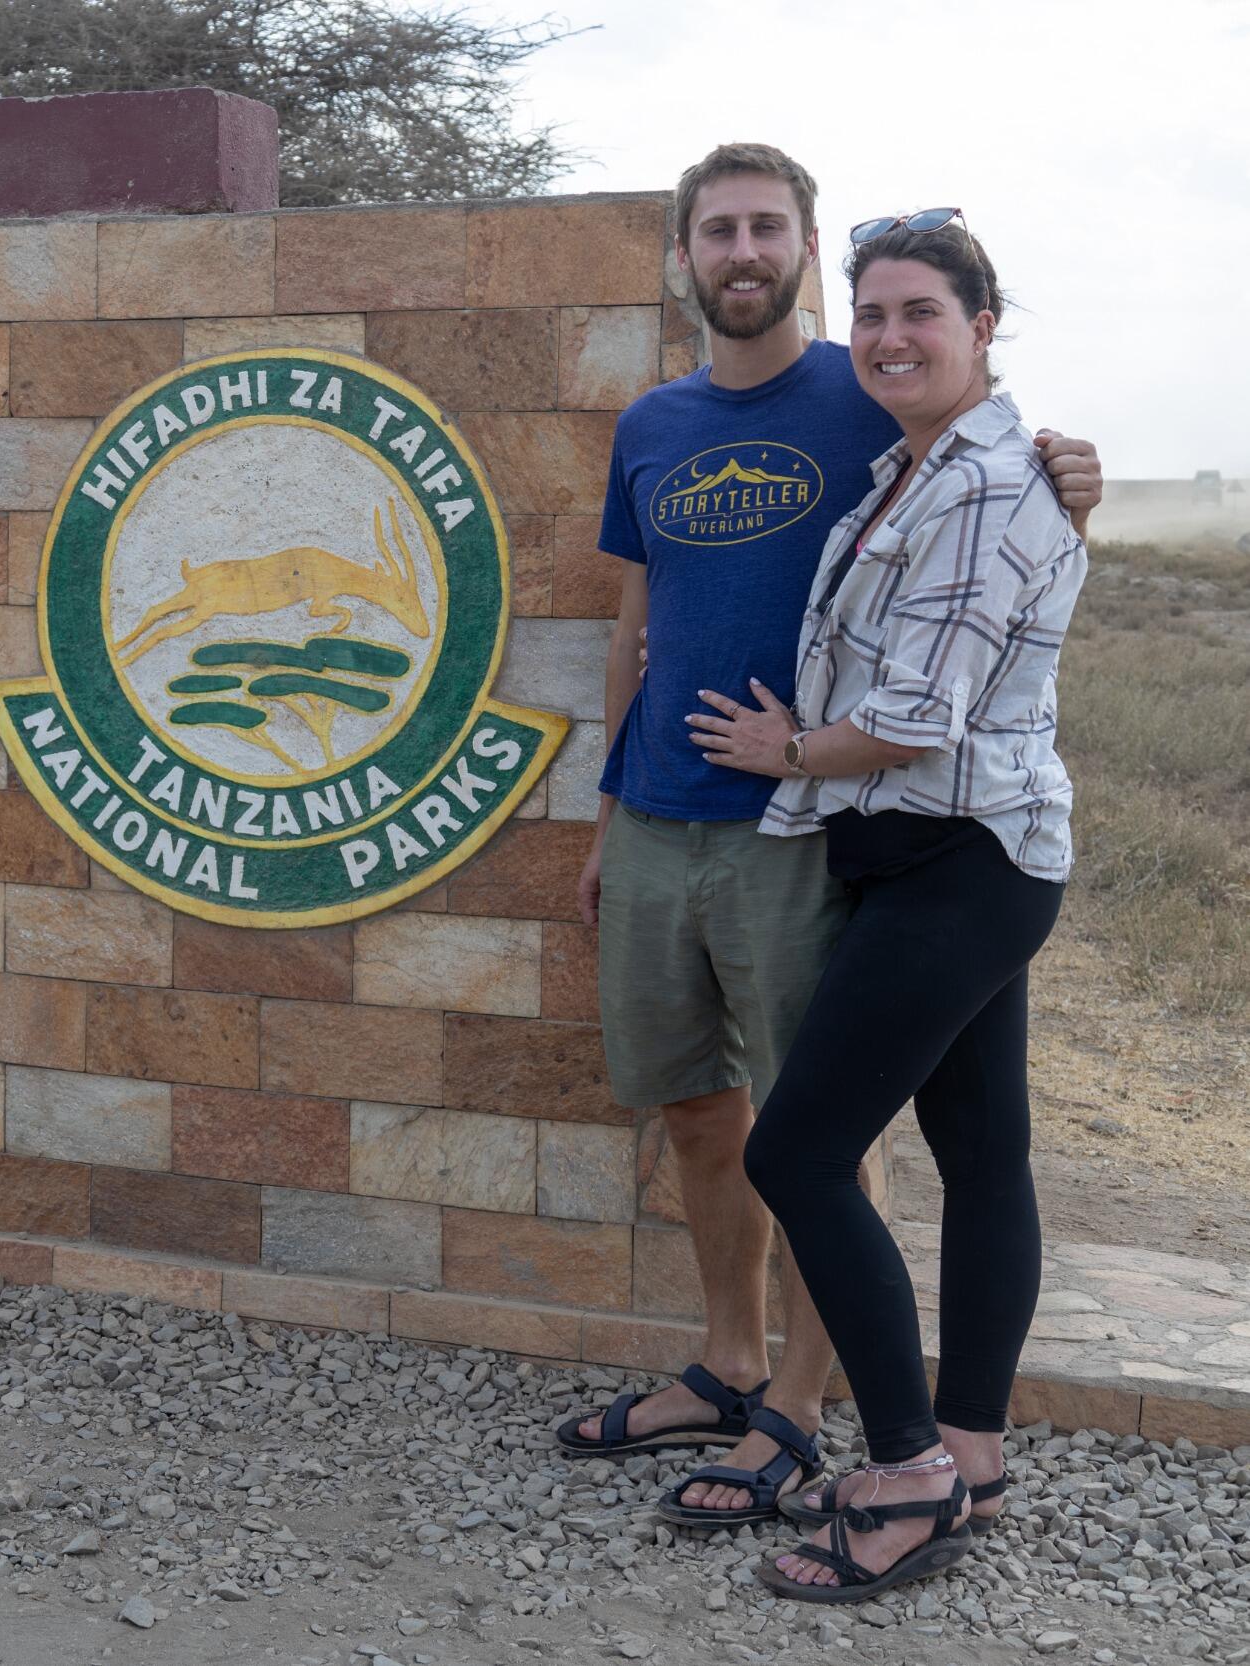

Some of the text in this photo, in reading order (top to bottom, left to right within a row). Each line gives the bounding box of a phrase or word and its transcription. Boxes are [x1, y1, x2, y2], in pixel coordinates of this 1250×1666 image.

[80, 368, 476, 534] HIFADHI ZA TAIFA
[657, 482, 809, 521] STORYTELLER
[688, 513, 764, 534] OVERLAND
[22, 706, 523, 901] NATIONAL PARKS
[123, 735, 403, 837] TANZANIA
